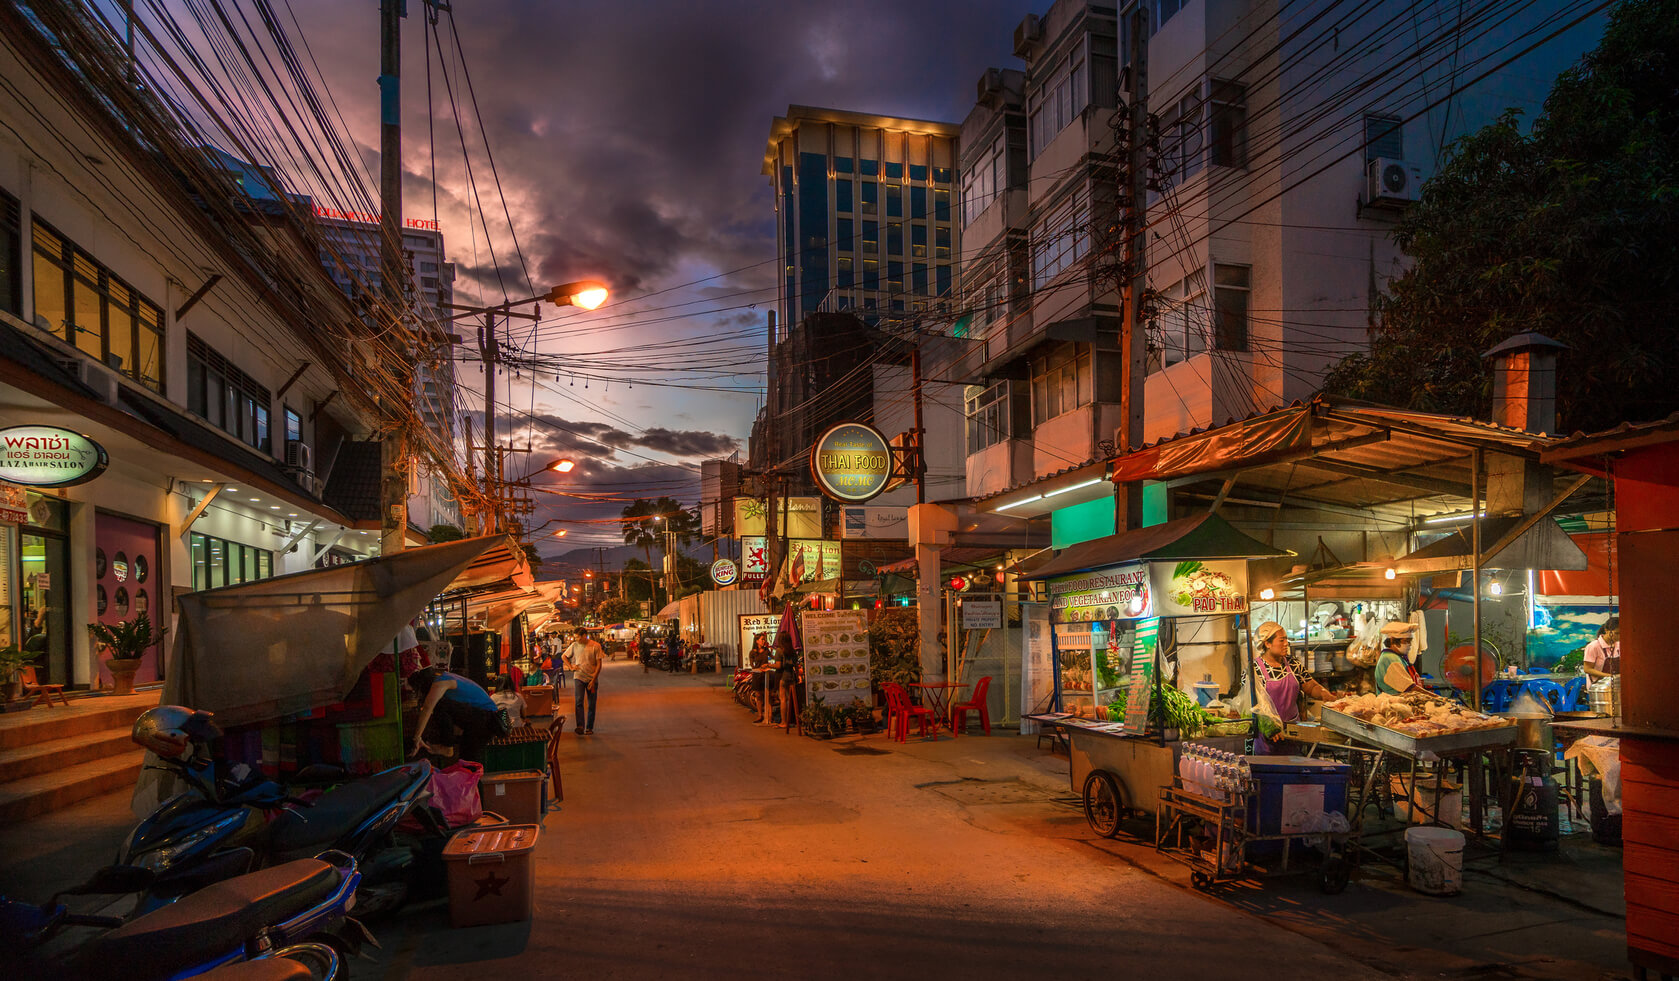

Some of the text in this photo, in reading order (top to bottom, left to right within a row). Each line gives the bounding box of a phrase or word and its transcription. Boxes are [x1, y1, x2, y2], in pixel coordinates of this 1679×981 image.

[406, 218, 441, 231] HOTEL
[4, 434, 70, 451] พลาซ่า
[0, 460, 28, 468] LAZA
[49, 461, 85, 469] SALON
[821, 454, 886, 470] THAI FOOD
[715, 569, 734, 578] KING
[1050, 571, 1145, 595] THAI FOOD RESTAURANT
[1053, 596, 1069, 609] AND
[1068, 591, 1118, 608] VEGETARIAN
[1193, 597, 1245, 611] PAD THAI
[743, 618, 760, 626] Red
